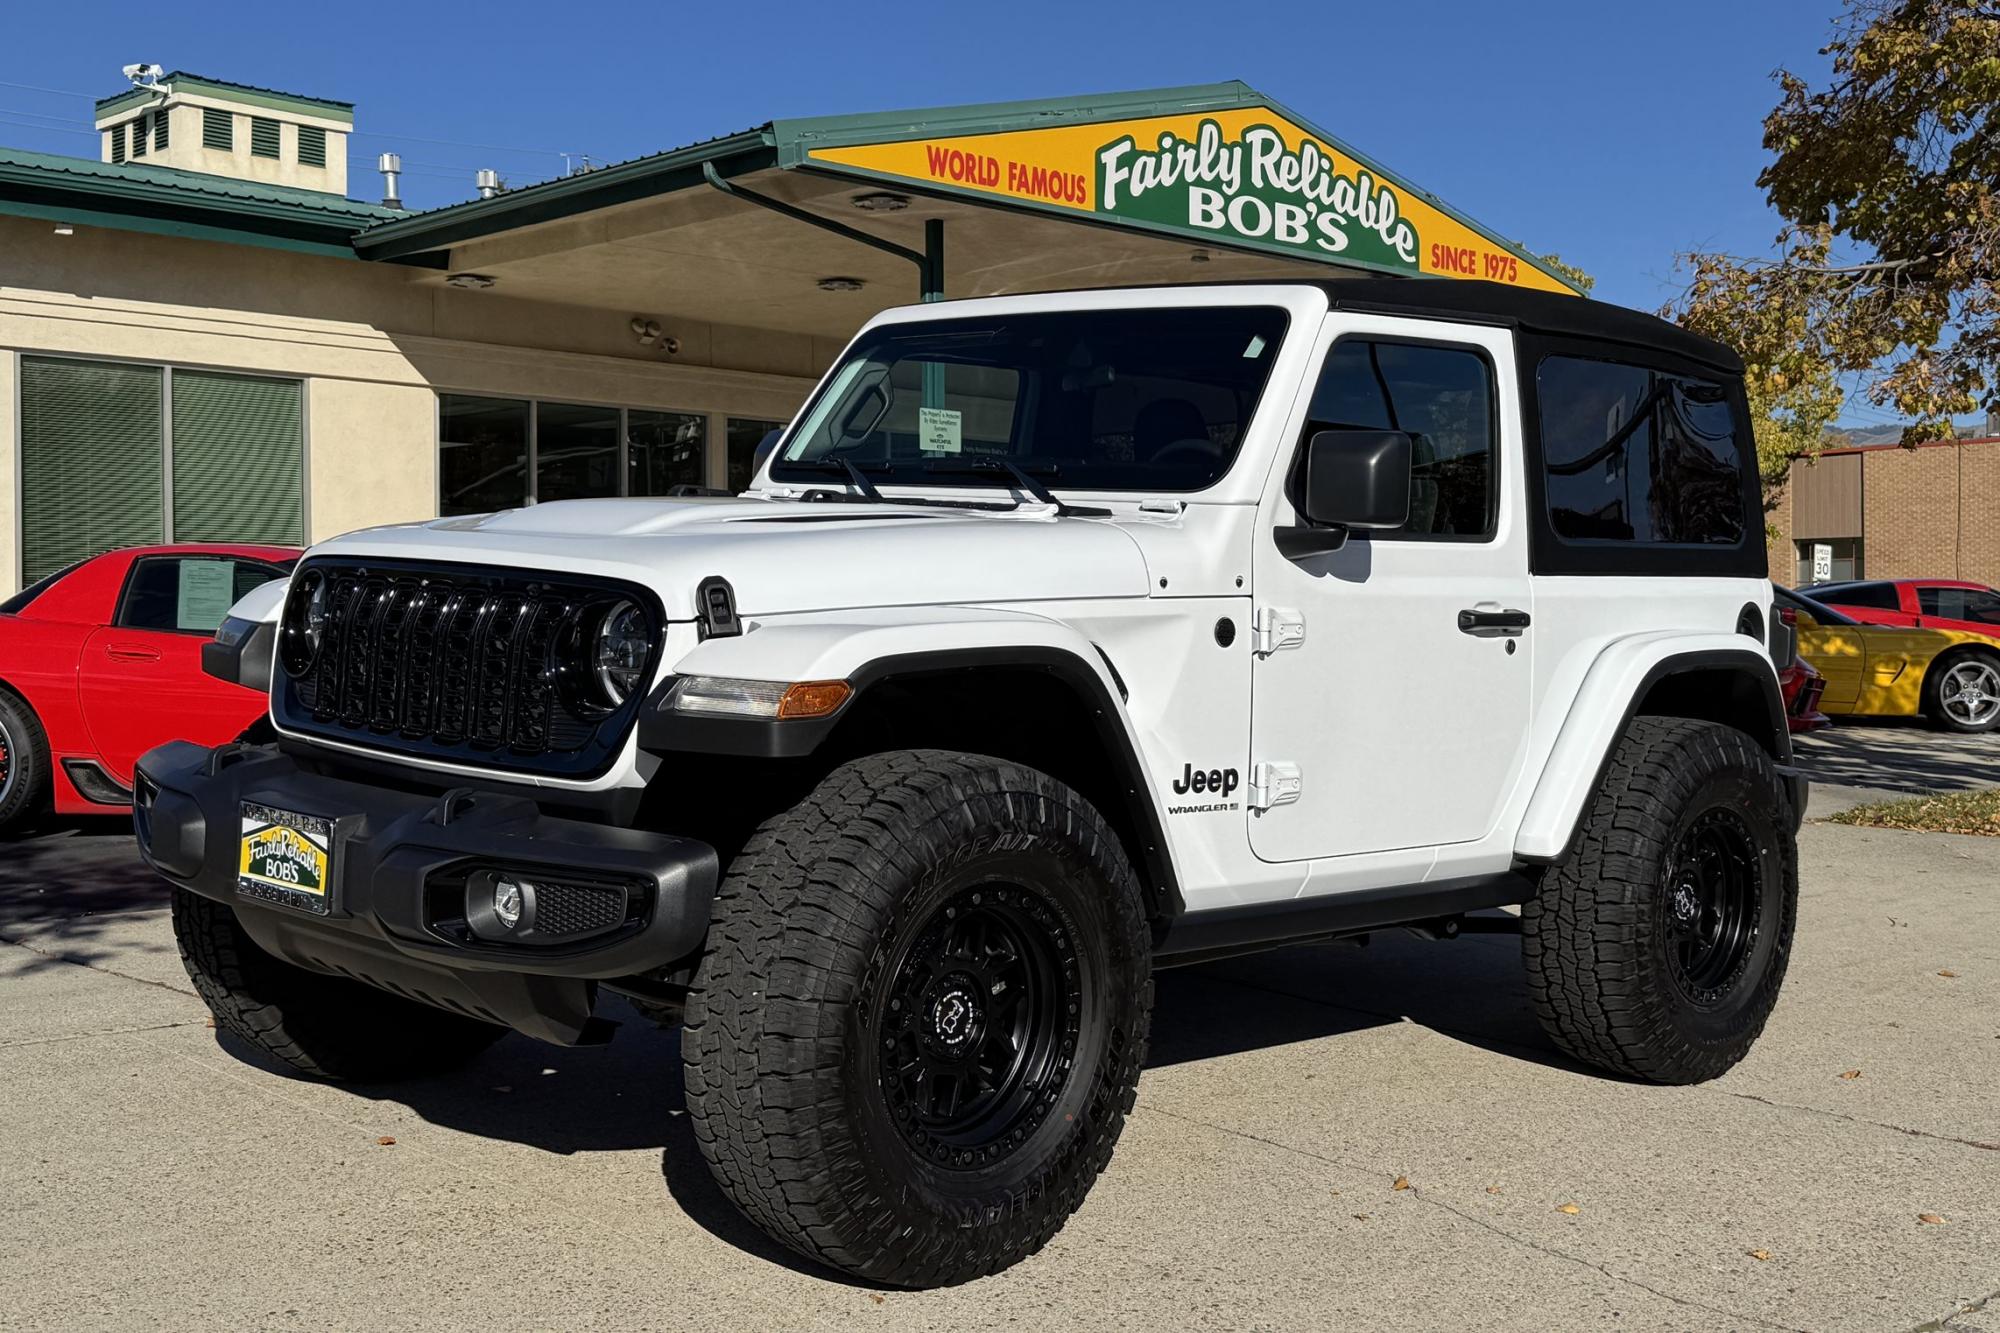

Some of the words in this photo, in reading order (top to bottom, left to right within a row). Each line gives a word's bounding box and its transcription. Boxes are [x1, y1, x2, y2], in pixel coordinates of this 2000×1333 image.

[926, 145, 1000, 187] WORLD
[1008, 161, 1086, 206] FAMOUS
[1100, 123, 1242, 209] Fairly
[1246, 129, 1416, 262] Reliable
[1189, 185, 1350, 252] BOB'S
[1430, 243, 1477, 276] SINCE
[1483, 252, 1518, 283] 1975
[1815, 562, 1829, 575] 30
[1172, 763, 1239, 798] Jeep
[1168, 803, 1228, 815] WRANGLER
[248, 833, 282, 864] Fairly
[280, 830, 321, 880] Reliable
[265, 857, 300, 884] BOB'S
